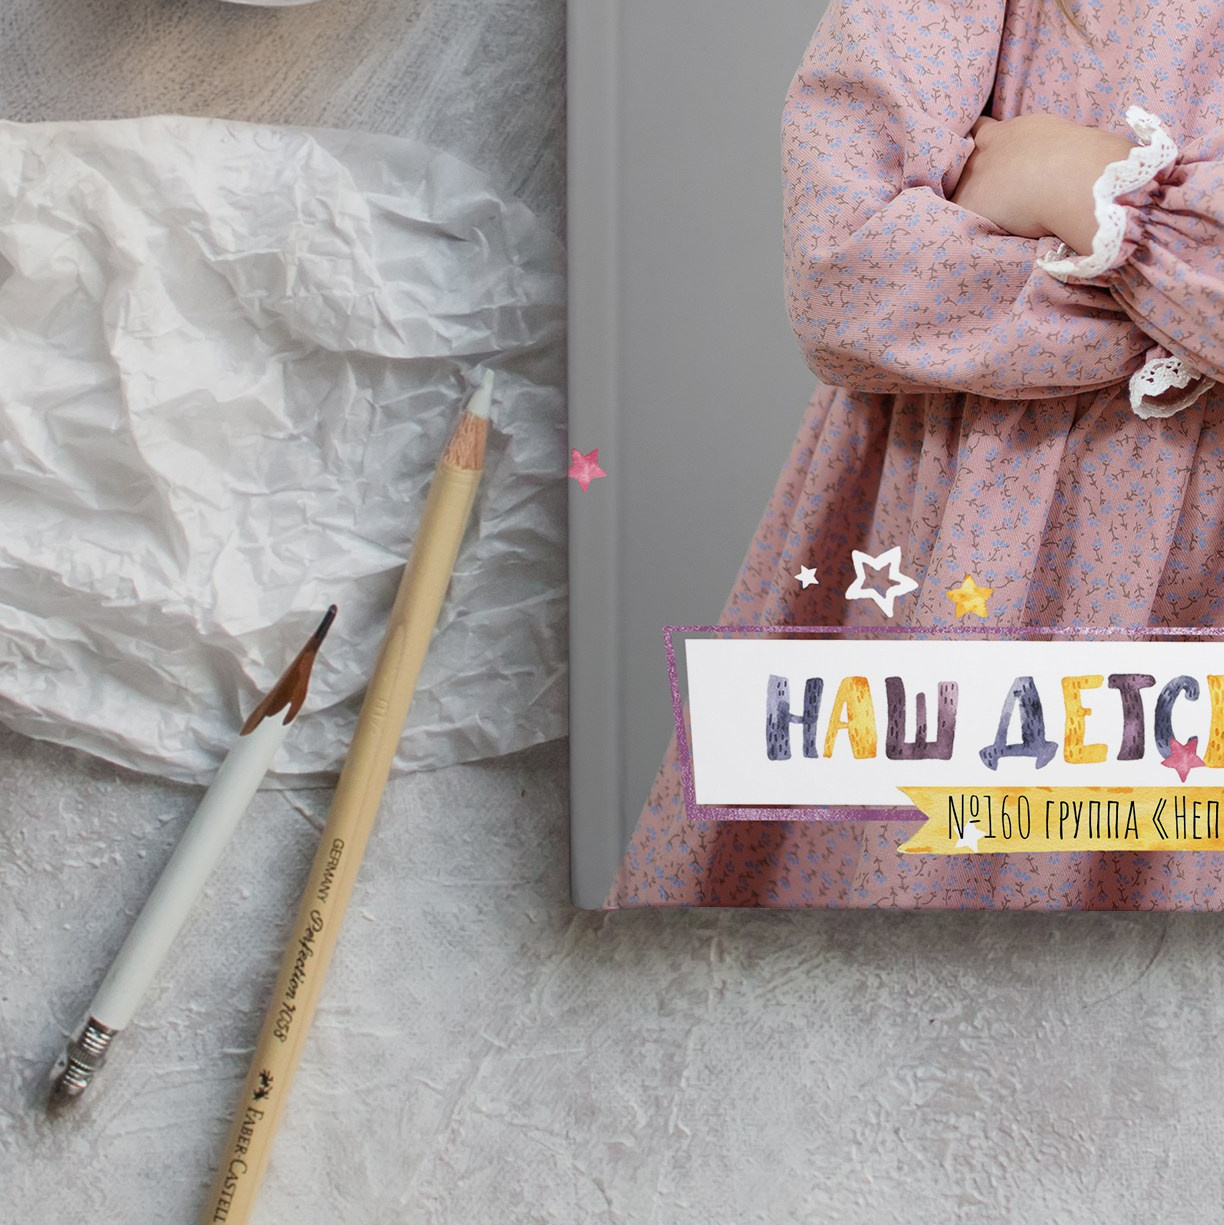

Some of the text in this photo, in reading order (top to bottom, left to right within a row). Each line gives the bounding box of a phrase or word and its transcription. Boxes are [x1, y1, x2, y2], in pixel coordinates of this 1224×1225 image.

[766, 674, 959, 761] НАШ
[947, 793, 1031, 840] №160
[316, 837, 345, 904] GERMANY
[286, 909, 324, 1000] Perfection
[213, 1106, 265, 1224] FABER-CASTELL
